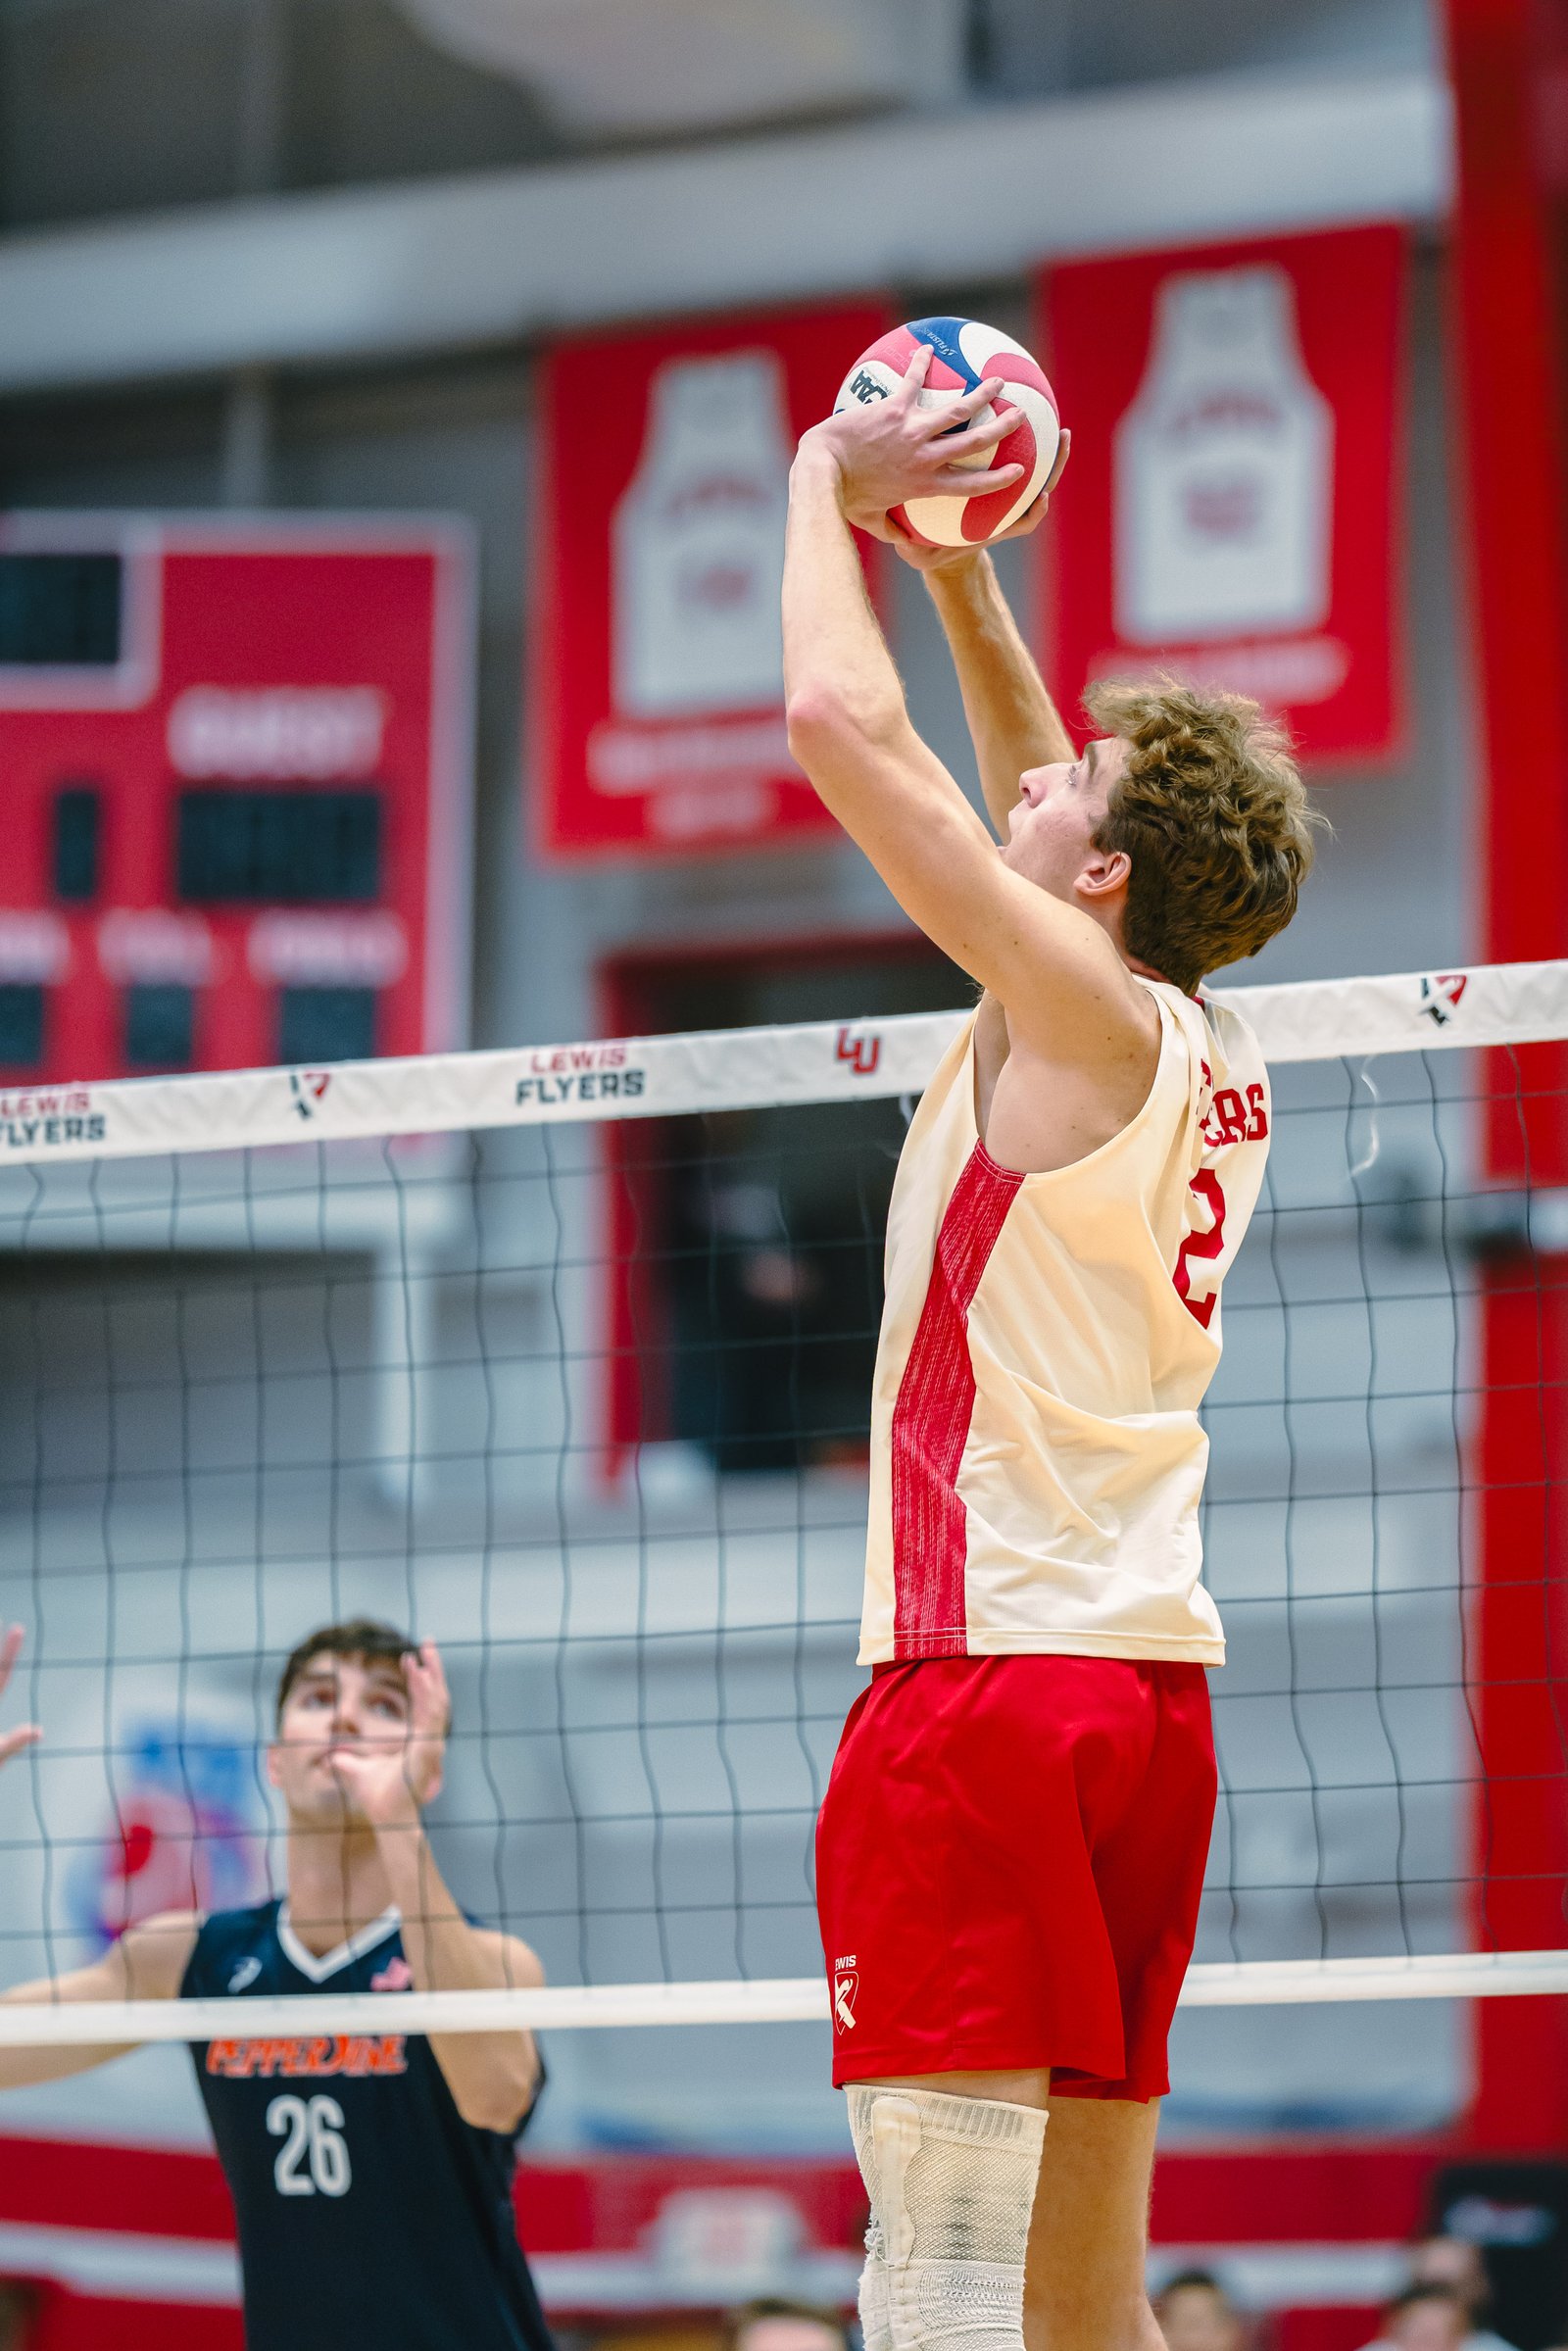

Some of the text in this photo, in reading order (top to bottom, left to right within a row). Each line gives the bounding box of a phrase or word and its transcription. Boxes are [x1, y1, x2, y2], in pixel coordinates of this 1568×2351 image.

[531, 1048, 626, 1072] LEWIS
[515, 1069, 644, 1104] FLYERS
[1, 1093, 90, 1119] LEWIS
[1199, 1060, 1268, 1148] ERS
[0, 1114, 105, 1147] LYERS
[1173, 1168, 1226, 1330] 2
[835, 1955, 857, 1971] EWIS
[267, 2095, 352, 2197] 26
